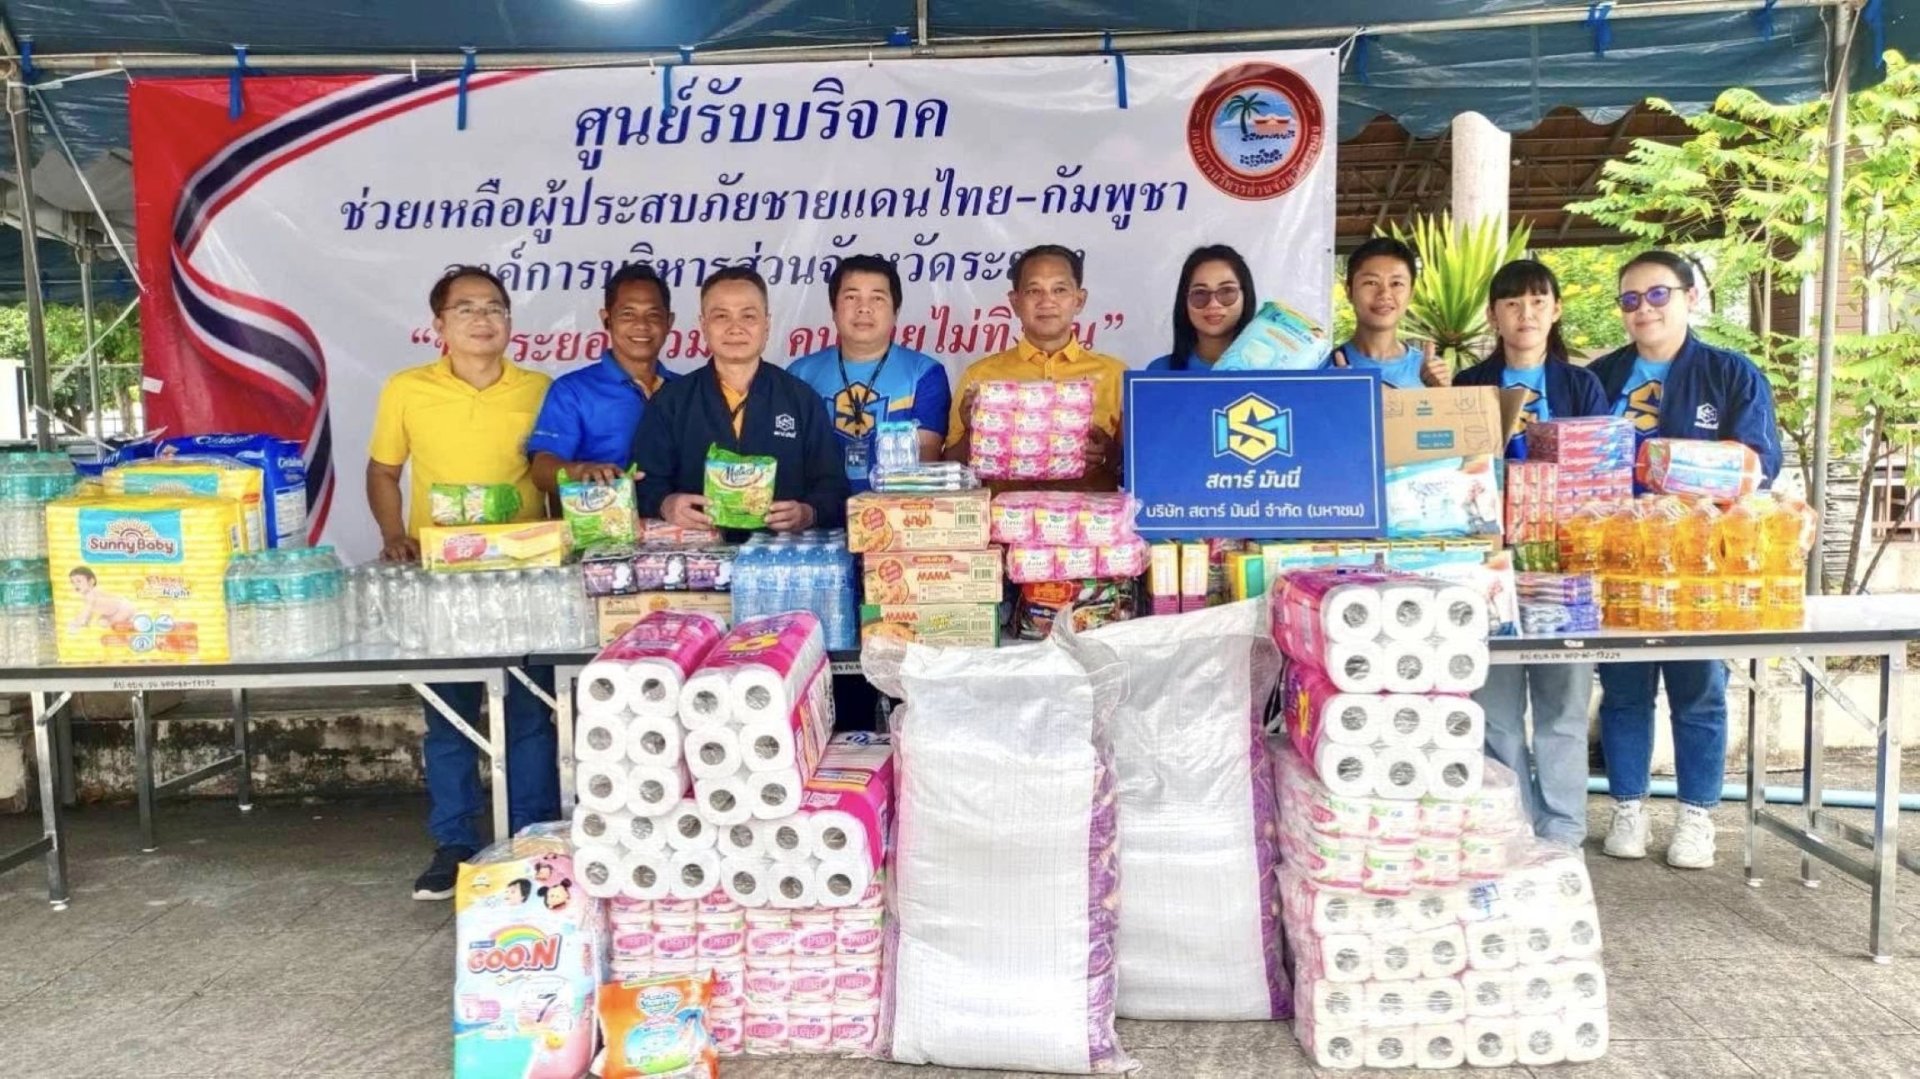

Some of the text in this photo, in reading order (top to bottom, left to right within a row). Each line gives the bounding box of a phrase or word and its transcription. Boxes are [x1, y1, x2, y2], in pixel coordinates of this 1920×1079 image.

[575, 76, 950, 171] ศูนย์รับบริจาค
[340, 164, 1188, 244] ช่วยเหลือผู้ประสบภัยชายแดนไทย-กัมพูชา
[1205, 466, 1302, 489] สตาร์ มันนี่
[1146, 500, 1365, 519] บริษัท สตาร์ มันนี่ จำกัด (มหาชน)
[917, 571, 951, 581] MAMA
[885, 610, 919, 621] MAMA
